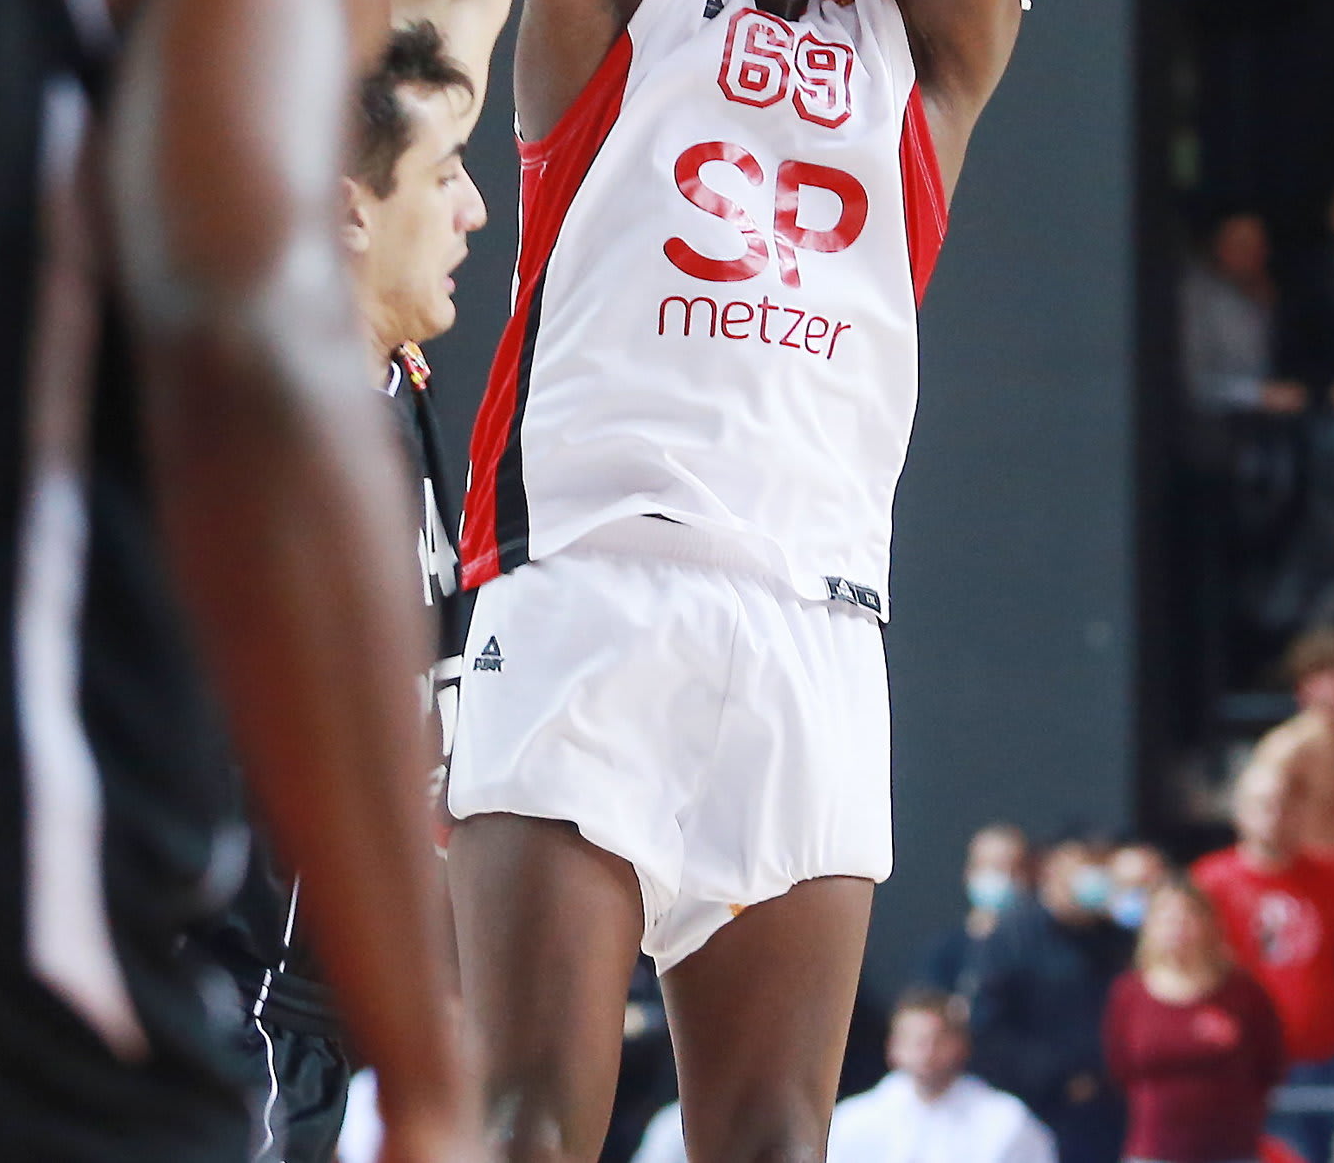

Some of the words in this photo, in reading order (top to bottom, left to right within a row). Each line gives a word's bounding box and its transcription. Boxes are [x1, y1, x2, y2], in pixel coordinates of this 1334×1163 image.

[716, 7, 854, 129] 69
[663, 140, 868, 288] SP
[657, 294, 852, 360] metzer
